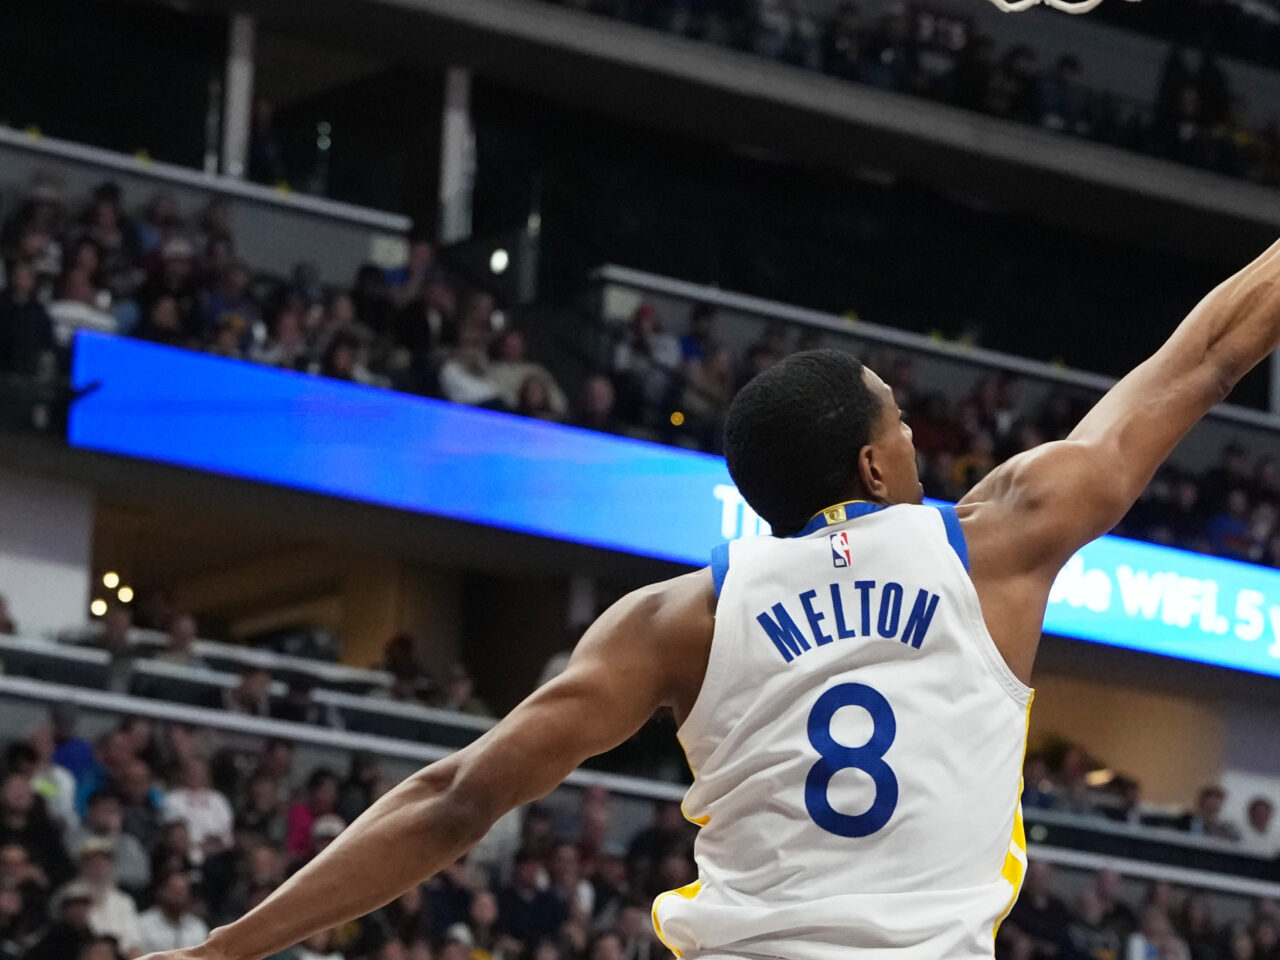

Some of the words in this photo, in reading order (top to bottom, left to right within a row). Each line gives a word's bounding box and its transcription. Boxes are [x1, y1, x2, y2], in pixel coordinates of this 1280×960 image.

[756, 580, 940, 664] MELTON
[1233, 589, 1265, 641] 5
[804, 682, 899, 838] 8
